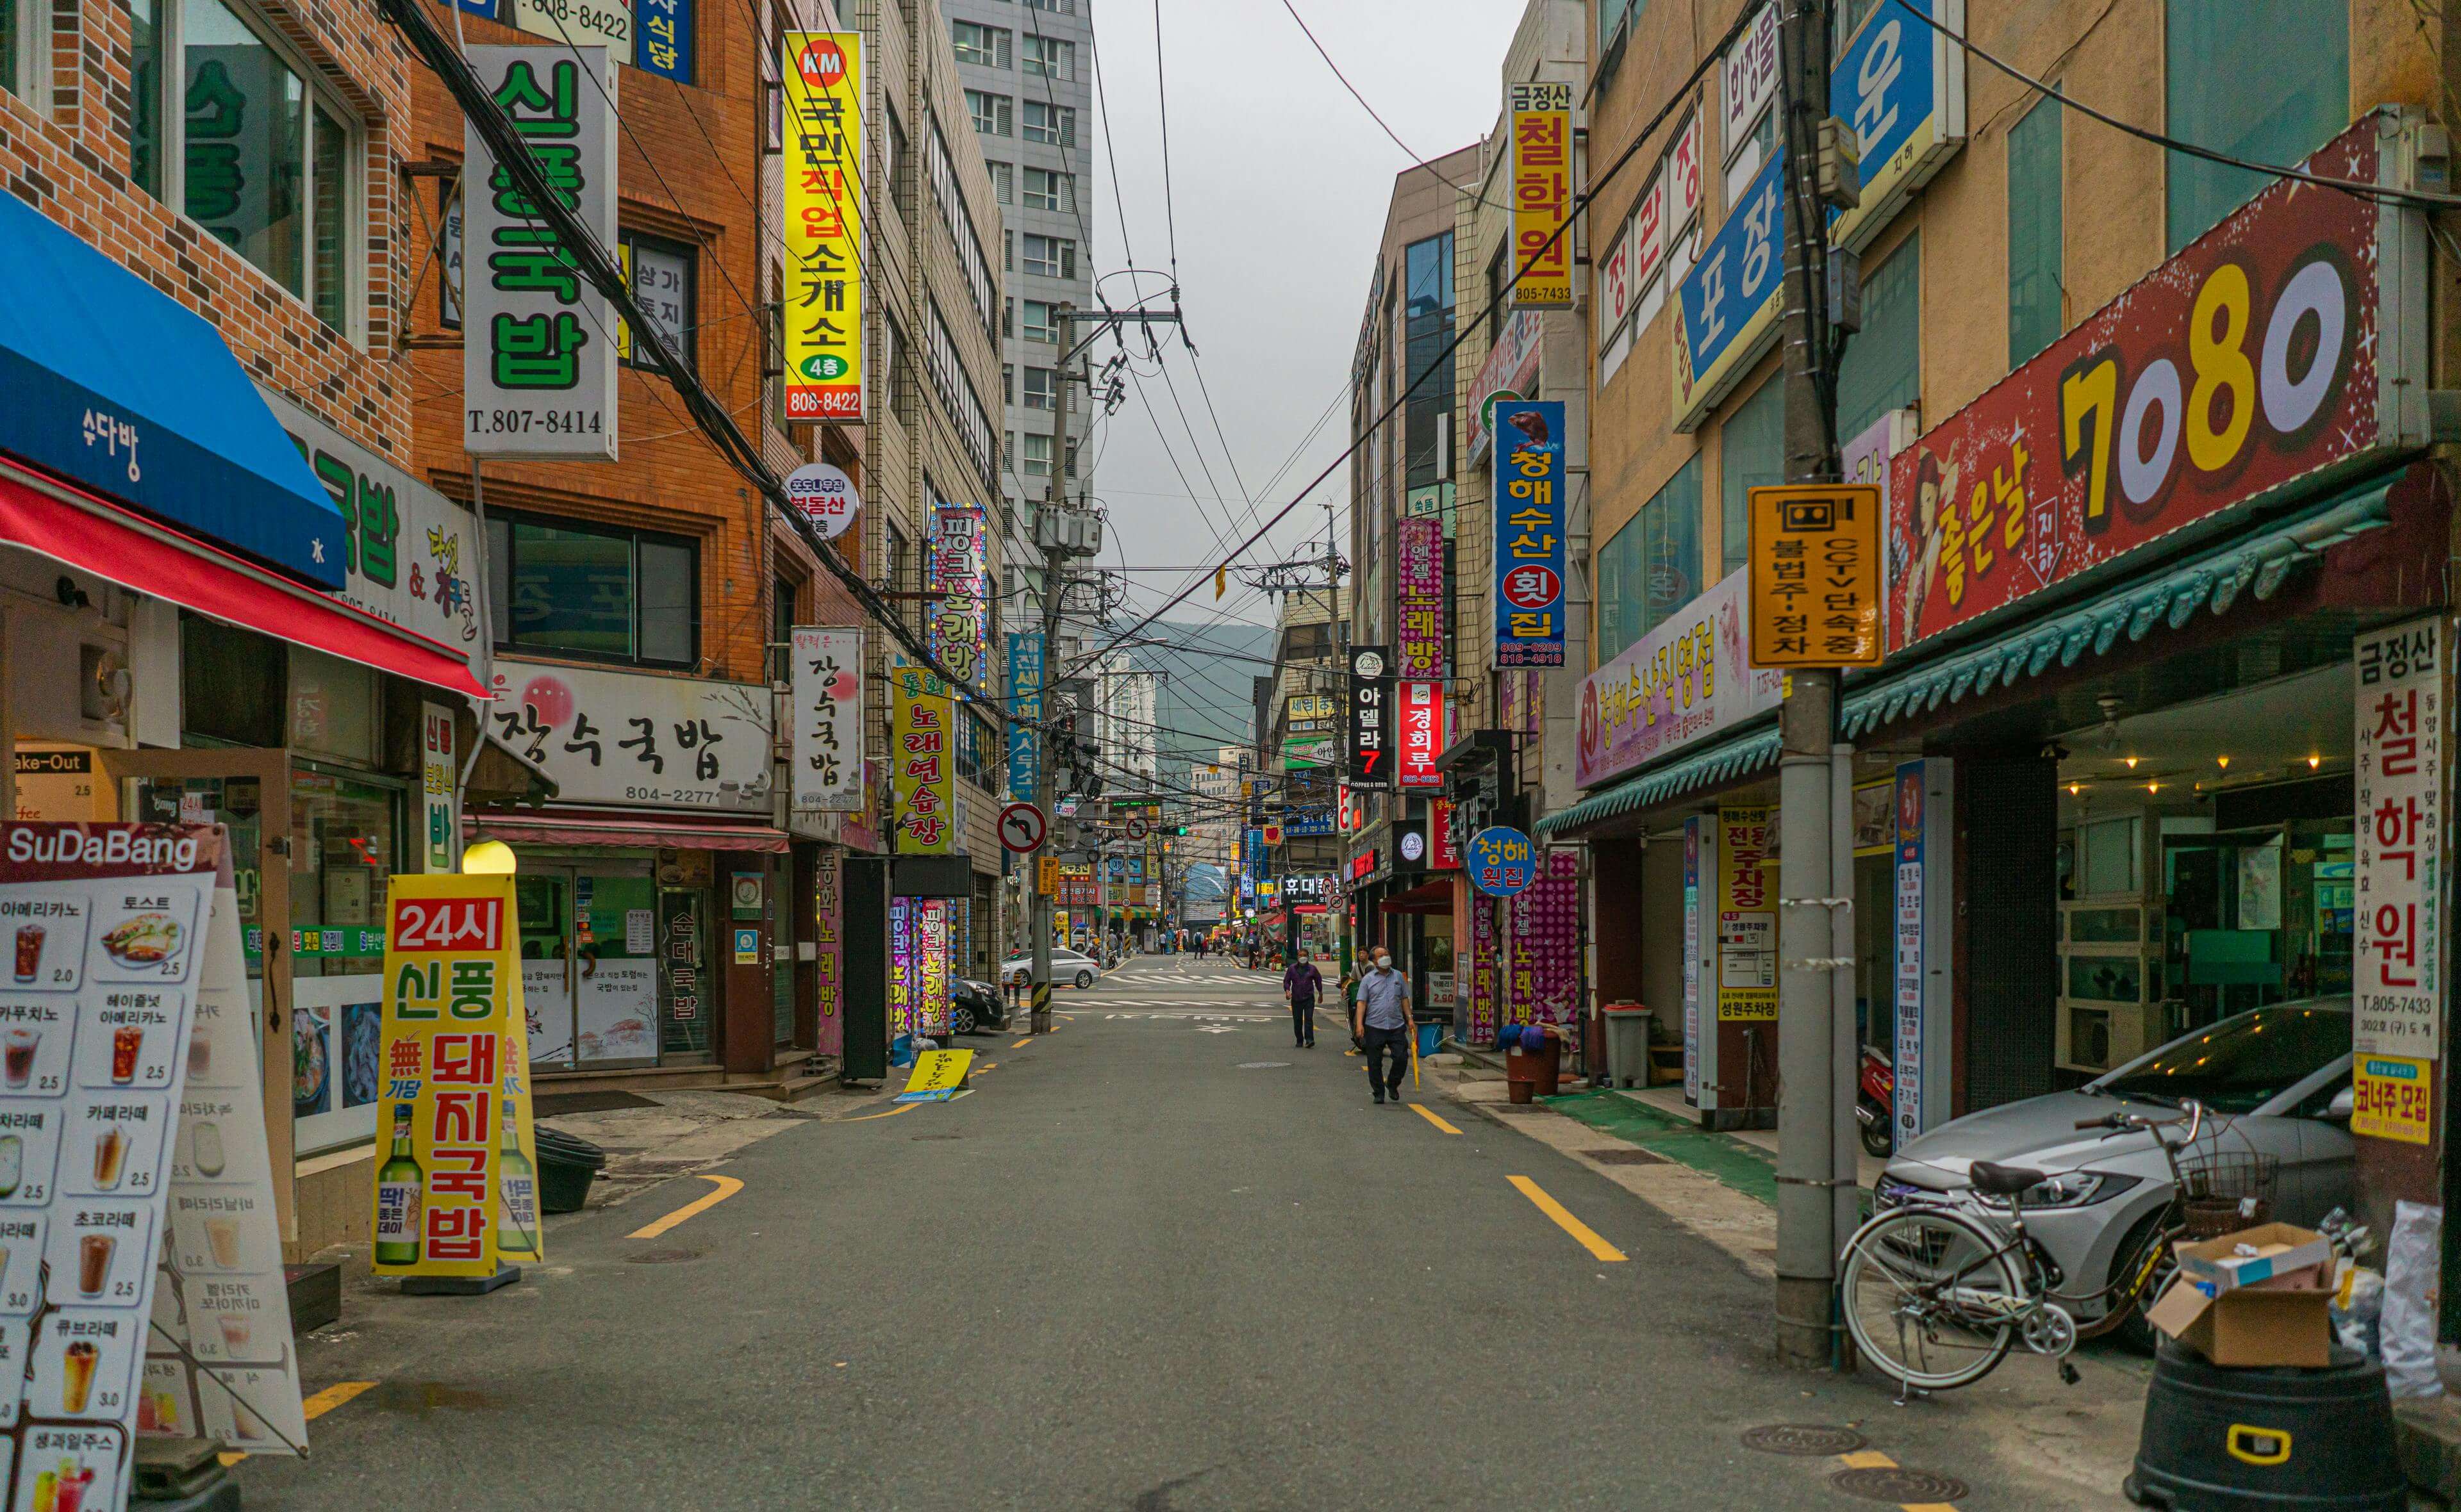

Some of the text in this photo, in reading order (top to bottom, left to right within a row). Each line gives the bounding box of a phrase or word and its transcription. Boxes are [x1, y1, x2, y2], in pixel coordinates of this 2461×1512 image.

[803, 53, 841, 74] KM
[1730, 10, 1777, 126] 화장품
[1512, 85, 1571, 111] 금정산
[1893, 144, 1914, 175] 지하
[1516, 117, 1567, 277] 철학원
[489, 60, 588, 390] 신풍국밥
[799, 96, 846, 349] 국민직업소개소
[1609, 132, 1700, 320] 정관장
[1516, 288, 1571, 300] 805-7433
[809, 357, 838, 377] 4층
[2057, 261, 2346, 520] 7080
[790, 393, 859, 412] 808-8422
[468, 410, 601, 434] T.807-8414
[83, 408, 139, 483] 수다방
[791, 479, 845, 493] 포도나무집
[1414, 498, 1434, 513] 쑥뜸
[1937, 439, 2029, 605] 좋은날
[2038, 511, 2053, 571] 지하
[1410, 545, 1430, 580] 엔젤
[1500, 643, 1561, 652] 809-0209
[1500, 654, 1561, 663] 818-4918
[2358, 625, 2436, 684] 금정산
[901, 673, 948, 698] 동화
[1600, 613, 1714, 751] 청해수산직영점
[808, 655, 840, 787] 장수국밥
[494, 704, 722, 781] 장수국밥
[1407, 708, 1434, 773] 경회루
[14, 755, 81, 771] ake-Out
[902, 703, 948, 847] 노래연습장
[75, 785, 91, 796] 2.5
[626, 785, 714, 804] 804-2277
[7, 827, 199, 872] SuDaBang
[2373, 689, 2424, 989] 철학원
[1478, 837, 1529, 865] 청해
[1482, 867, 1524, 888] 횟집
[1732, 850, 1765, 908] 주차장
[1, 900, 81, 918] 아메리카노
[122, 896, 170, 908] 토스트
[396, 901, 499, 949] 24시
[54, 969, 73, 982] 2.0
[161, 962, 181, 975] 2.5
[673, 912, 698, 1020] 순대국밥
[106, 994, 161, 1008] 헤이즐넛
[396, 961, 496, 1020] 신풍
[1722, 1003, 1776, 1018] 성원주차장
[2361, 993, 2431, 1016] T.805-7433
[100, 1010, 167, 1024] 아메리카노
[390, 1037, 422, 1078] 無
[39, 1076, 59, 1089] 2.5
[145, 1066, 165, 1079] 2.5
[385, 1079, 422, 1099] 가당
[87, 1105, 149, 1121] 카페라떼
[2399, 1085, 2430, 1124] 모집
[424, 1032, 496, 1261] 돼지국밥
[131, 1172, 149, 1186] 2.5
[24, 1185, 44, 1199] 2.5
[74, 1212, 137, 1228] 초코라떼
[8, 1292, 28, 1307] 3.0
[115, 1282, 134, 1295] 2.5
[56, 1320, 118, 1338] 큐브라떼
[99, 1392, 119, 1406] 3.0
[34, 1432, 113, 1451] 생과일주스
